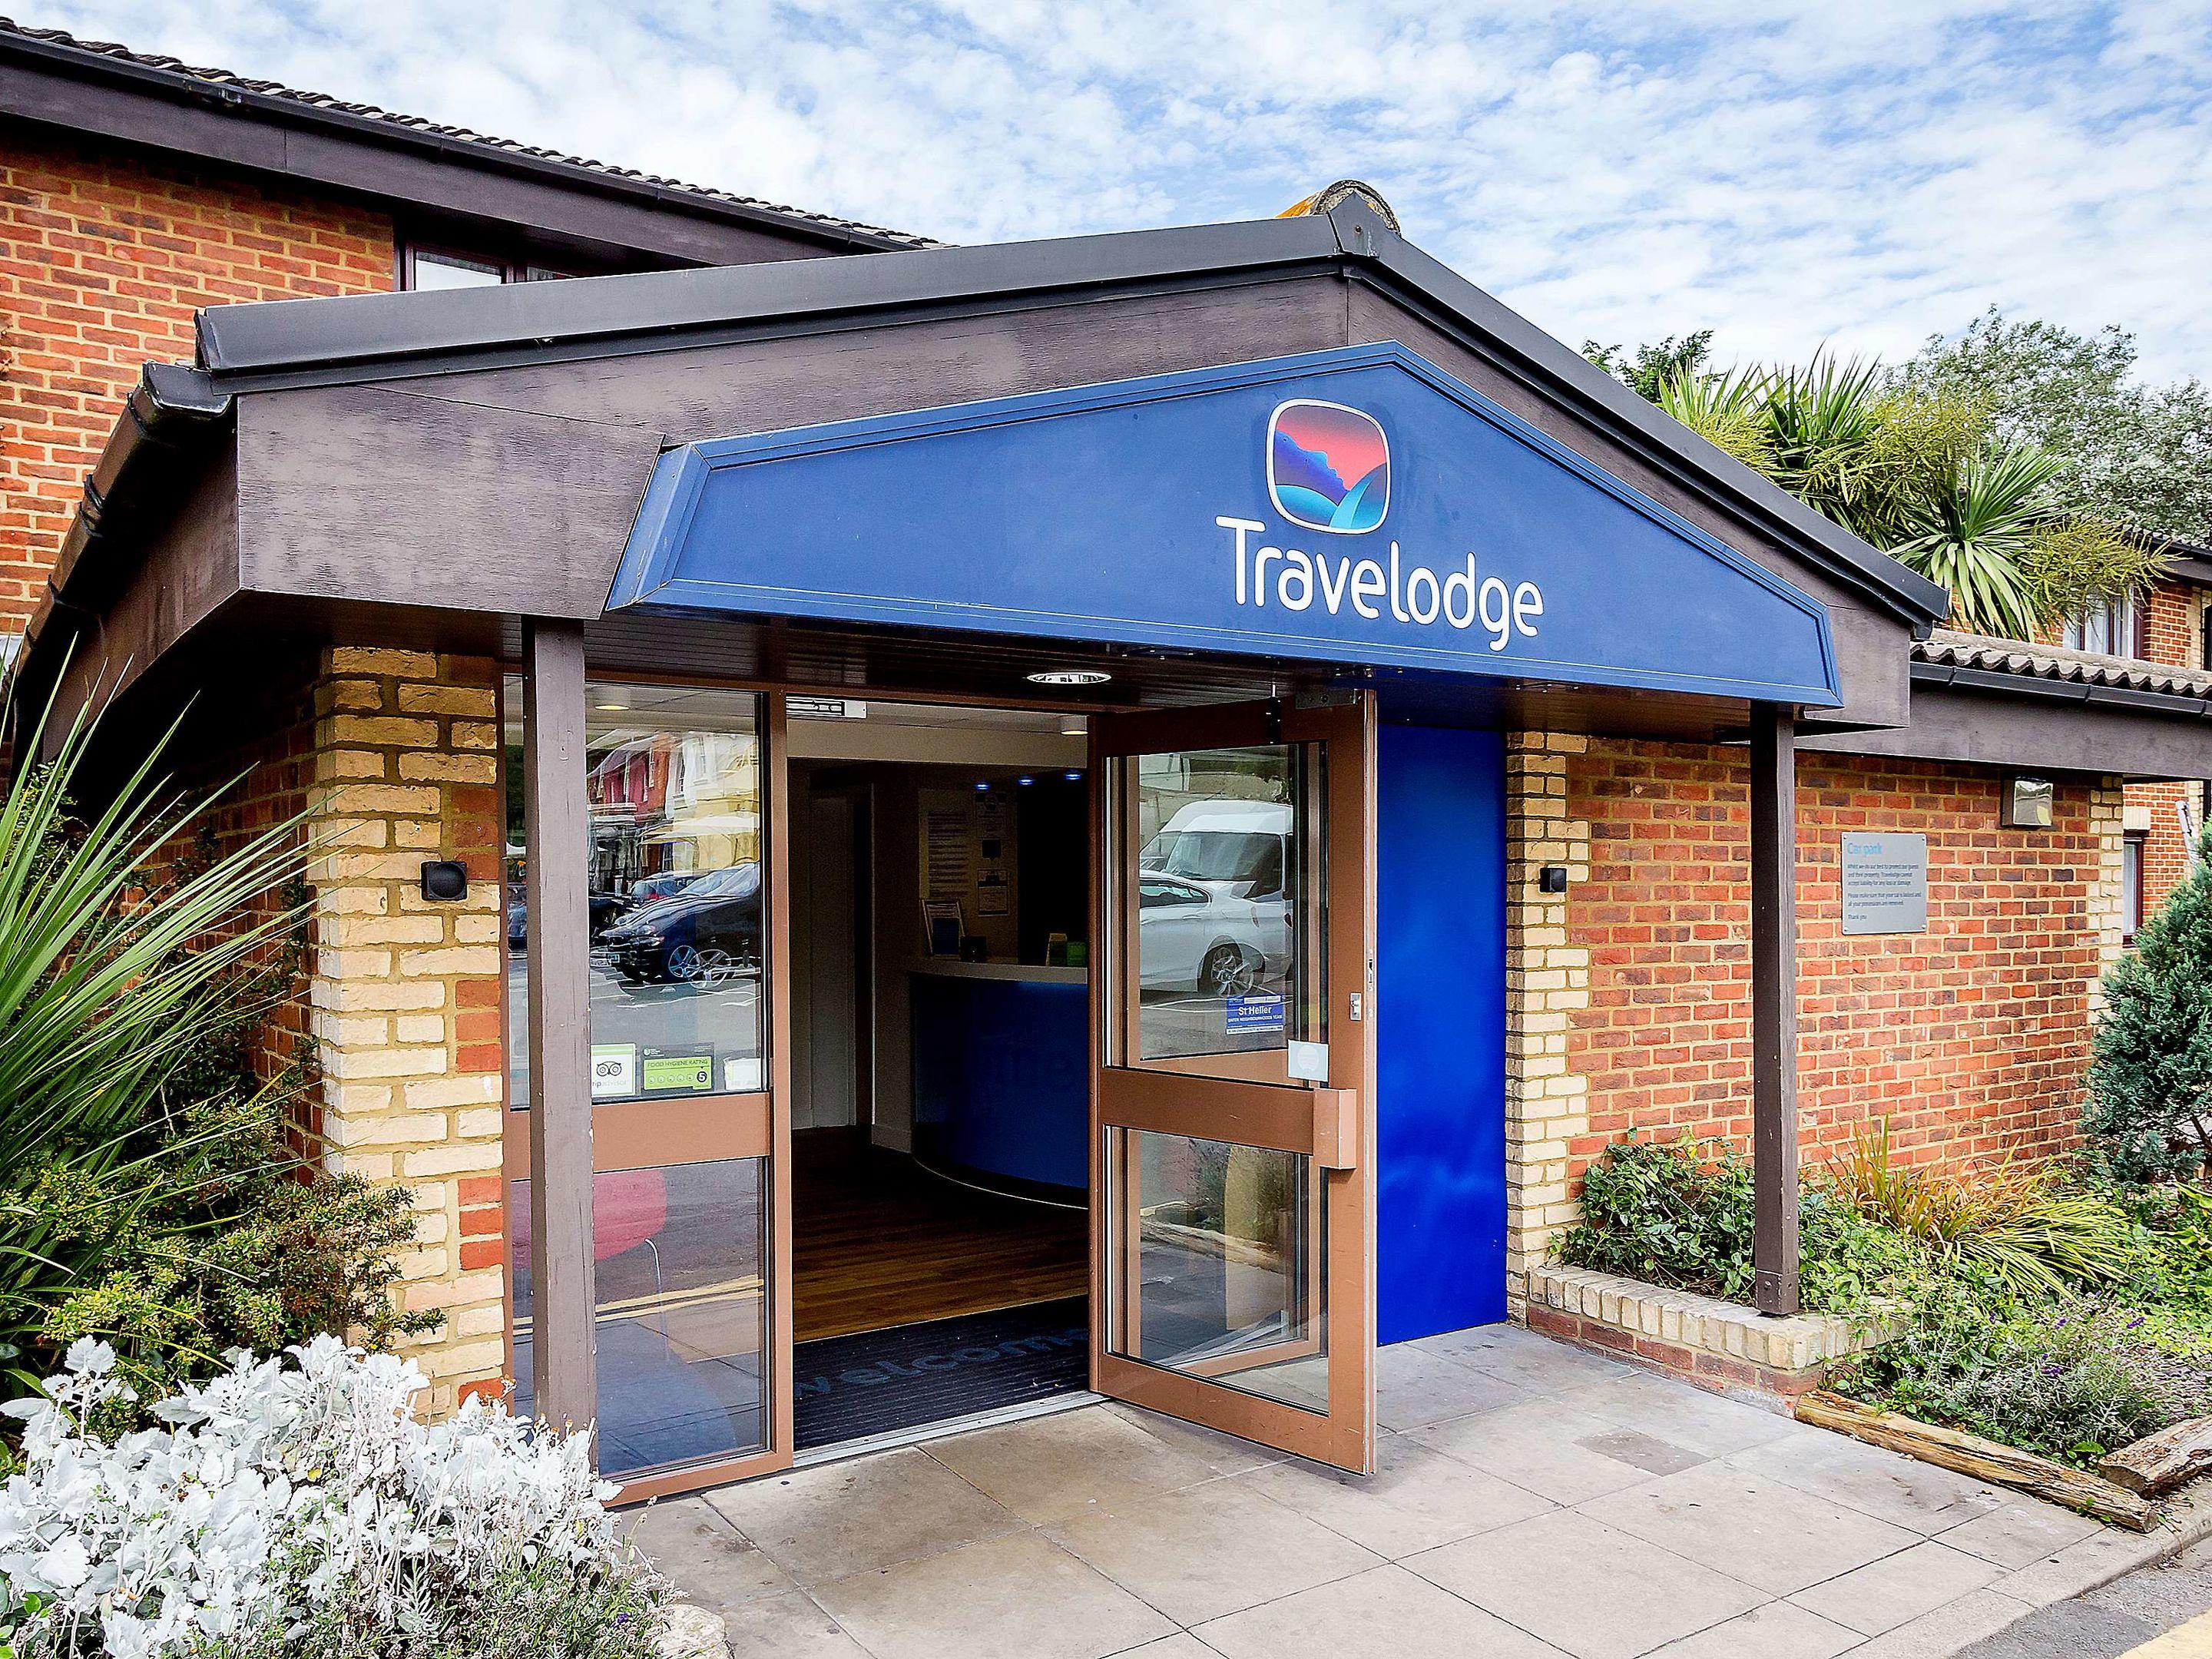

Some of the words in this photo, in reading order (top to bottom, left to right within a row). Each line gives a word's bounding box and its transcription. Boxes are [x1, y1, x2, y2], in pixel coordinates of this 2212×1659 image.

[1214, 515, 1544, 652] Travelodge
[1847, 843, 1861, 854] Car
[1863, 843, 1882, 858] park
[1238, 1007, 1248, 1015] St
[698, 1072, 706, 1081] 5
